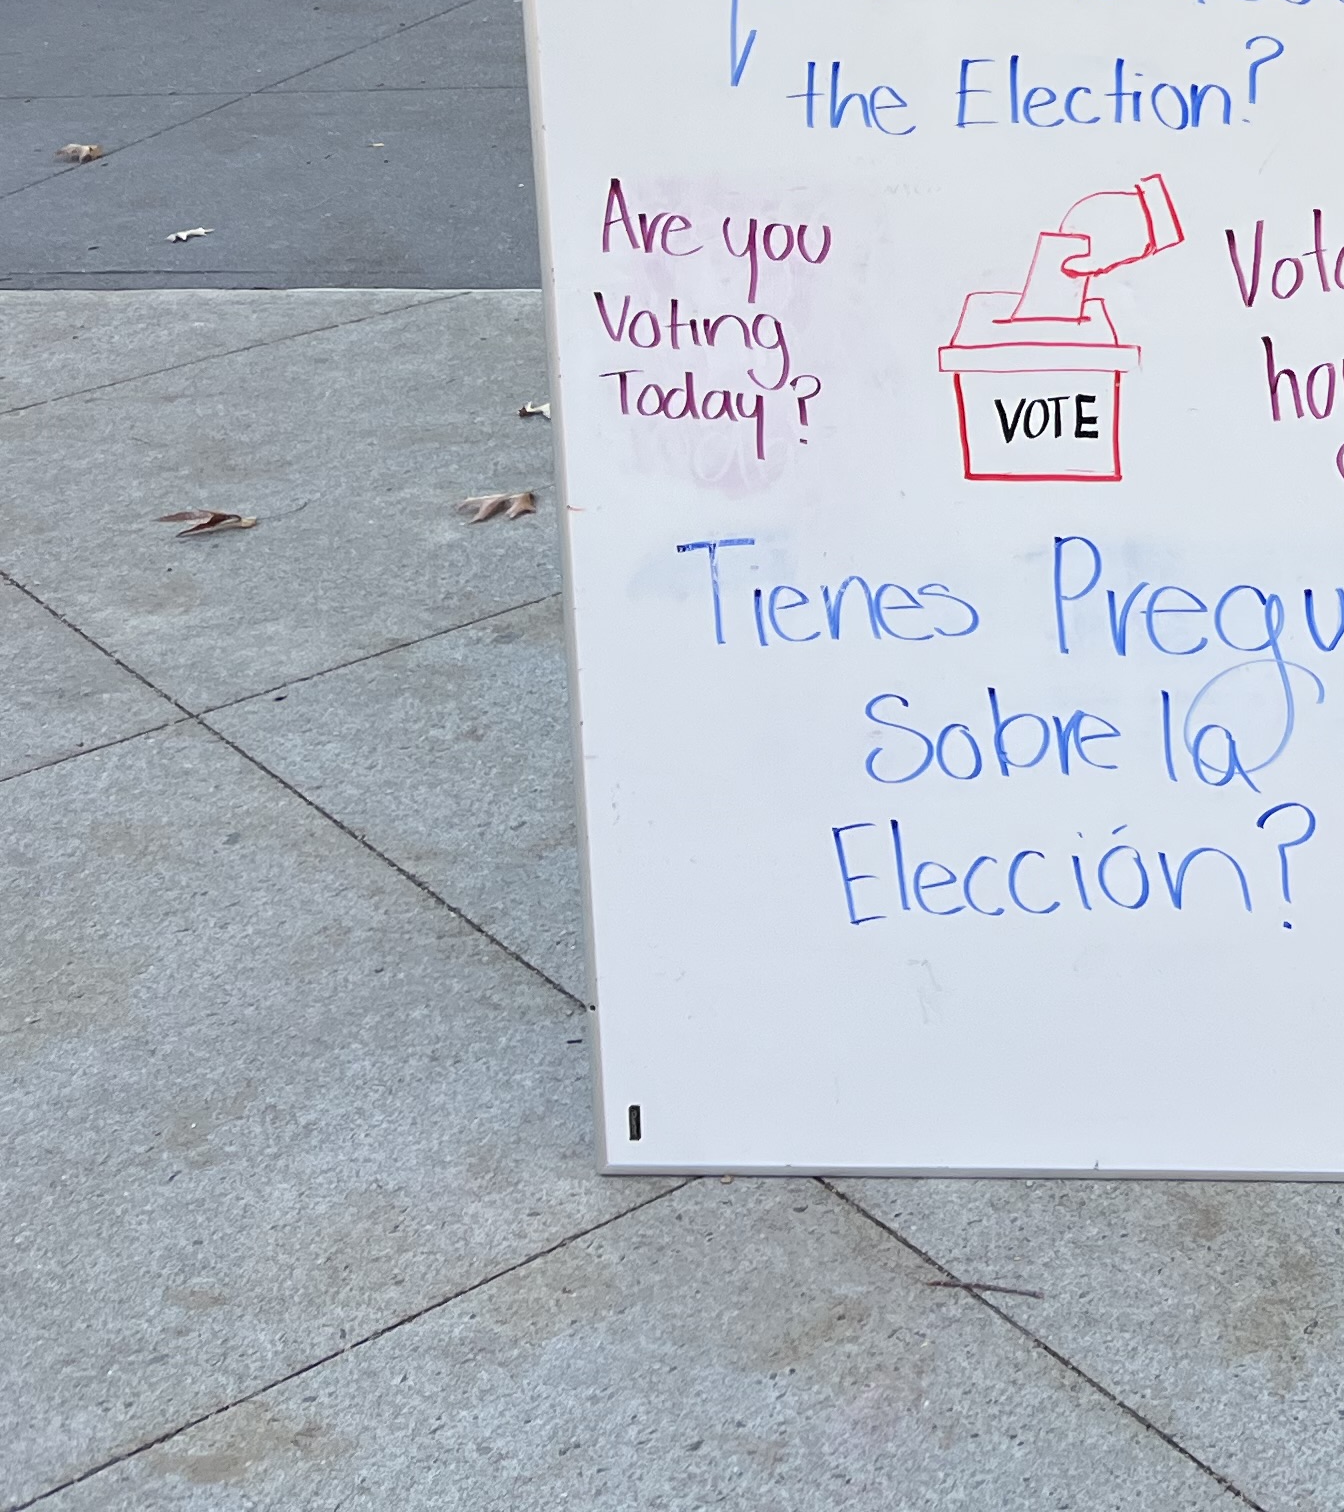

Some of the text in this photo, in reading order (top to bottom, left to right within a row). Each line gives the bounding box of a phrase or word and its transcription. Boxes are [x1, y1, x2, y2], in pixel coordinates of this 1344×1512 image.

[786, 35, 1285, 136] the Election?
[601, 178, 832, 304] Are you
[593, 291, 790, 391] Voting
[994, 394, 1100, 444] VOTE
[676, 537, 980, 647] Tienes
[865, 686, 1262, 793] Sobre la
[831, 802, 1317, 930] Elección?
